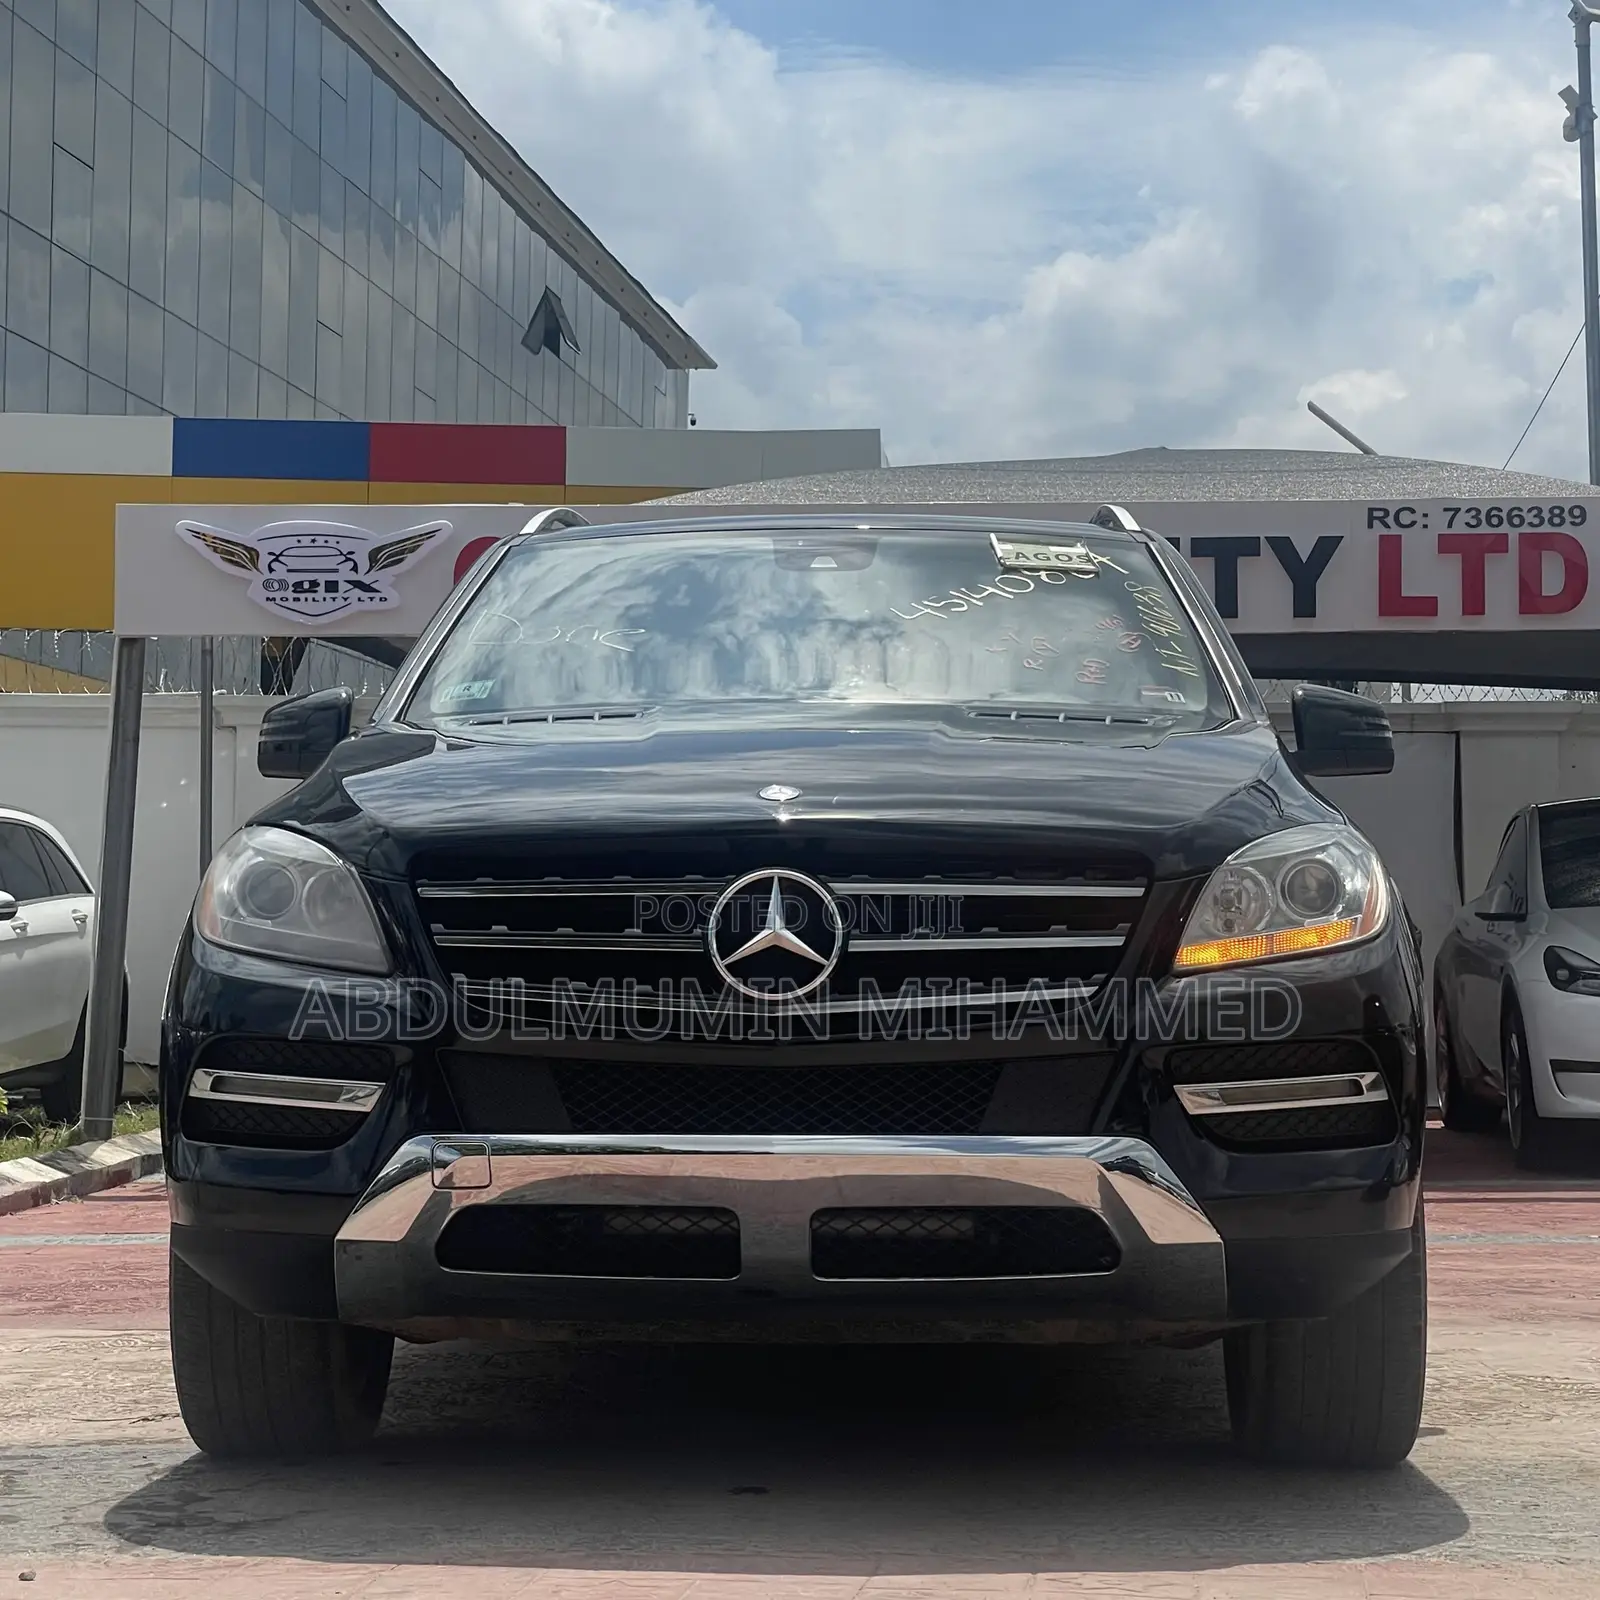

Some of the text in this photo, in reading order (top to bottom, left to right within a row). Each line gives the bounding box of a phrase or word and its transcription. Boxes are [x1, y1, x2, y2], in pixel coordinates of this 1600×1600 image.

[1367, 505, 1587, 529] RC: 7366389
[1004, 550, 1091, 564] AGOS
[1164, 532, 1589, 618] TY LTD
